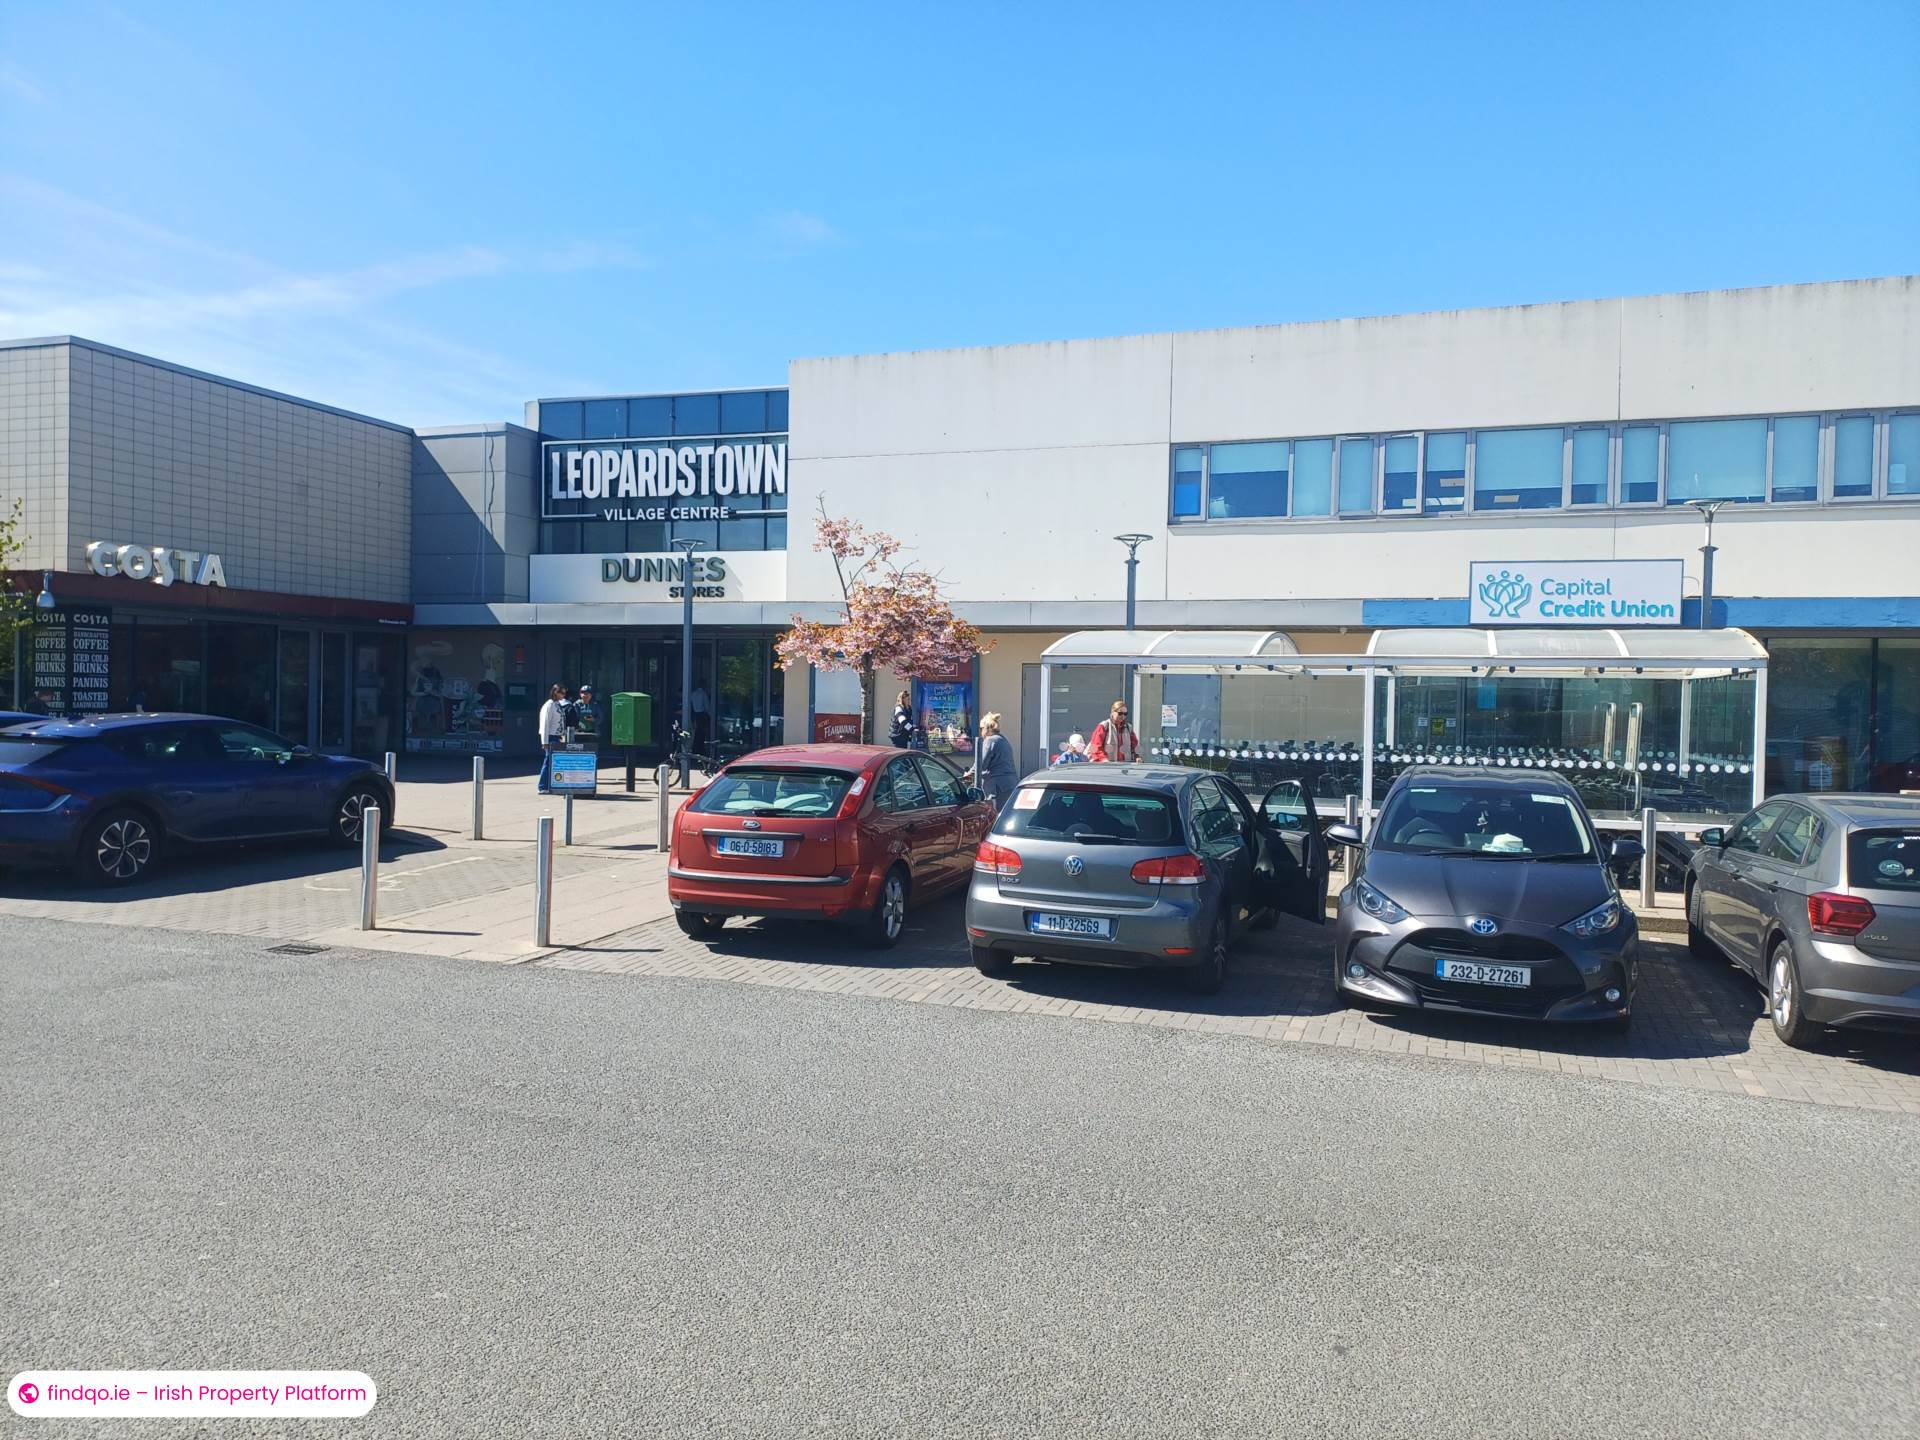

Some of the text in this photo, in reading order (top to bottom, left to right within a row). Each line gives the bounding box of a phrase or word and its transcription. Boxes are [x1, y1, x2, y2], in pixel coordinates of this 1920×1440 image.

[551, 443, 786, 499] LEOPARDSTOWN
[603, 506, 729, 521] VILLAGE CENTRE
[86, 541, 227, 588] COSTA
[1540, 578, 1612, 600] Capital
[1539, 600, 1675, 618] Credit Union
[35, 613, 66, 623] COSTA
[73, 614, 109, 625] COSTA
[35, 637, 66, 649] COFFEE
[73, 638, 109, 651] COFFEE
[36, 652, 66, 661] ICED COLD
[73, 653, 109, 663] ICED COLD
[35, 662, 66, 673] DRINKS
[73, 662, 109, 674] DRINKS
[35, 676, 66, 688] PANINIS
[73, 677, 109, 689] PANINIS
[73, 691, 109, 701] TOASTED
[1048, 917, 1099, 933] 11-D-32569
[1450, 964, 1524, 984] 232-D-27261
